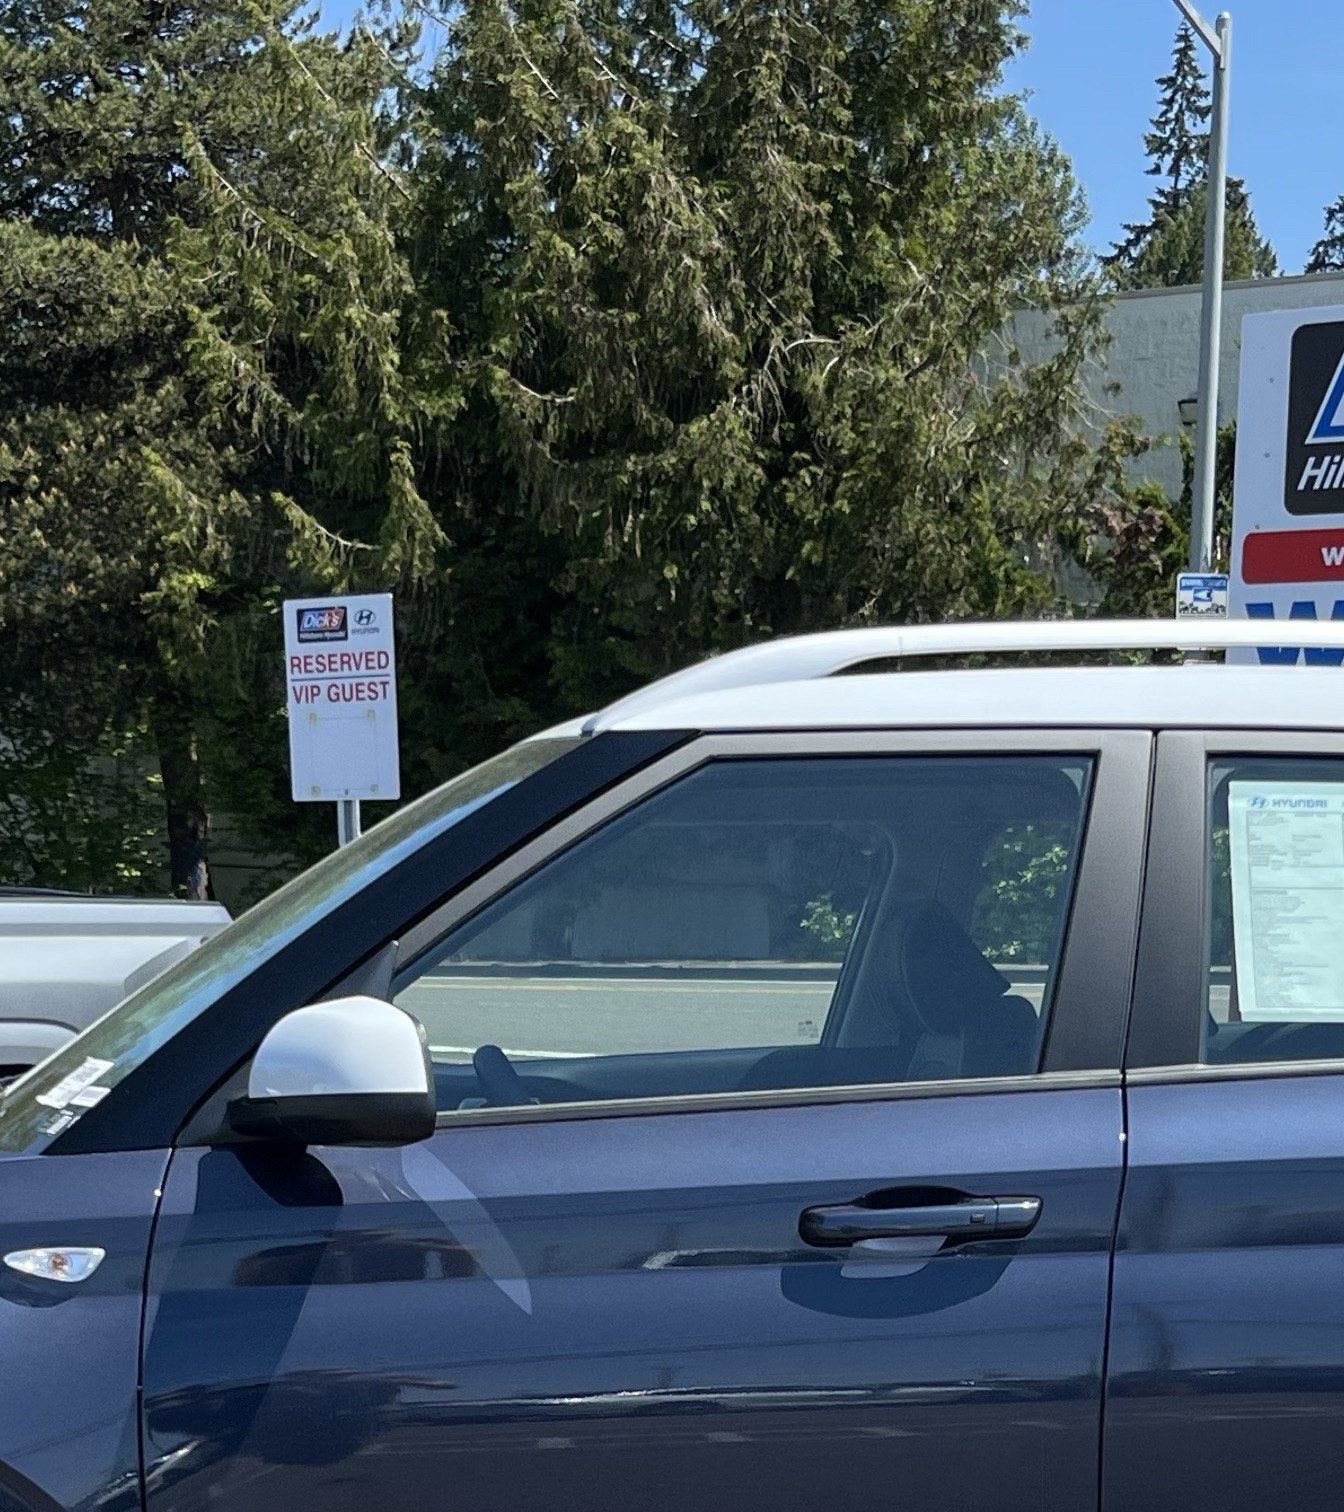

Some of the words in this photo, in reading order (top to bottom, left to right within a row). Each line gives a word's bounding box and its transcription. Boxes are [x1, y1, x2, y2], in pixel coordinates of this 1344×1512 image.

[290, 650, 390, 675] RESERVED
[292, 684, 322, 704] VIP
[327, 680, 390, 703] GUEST
